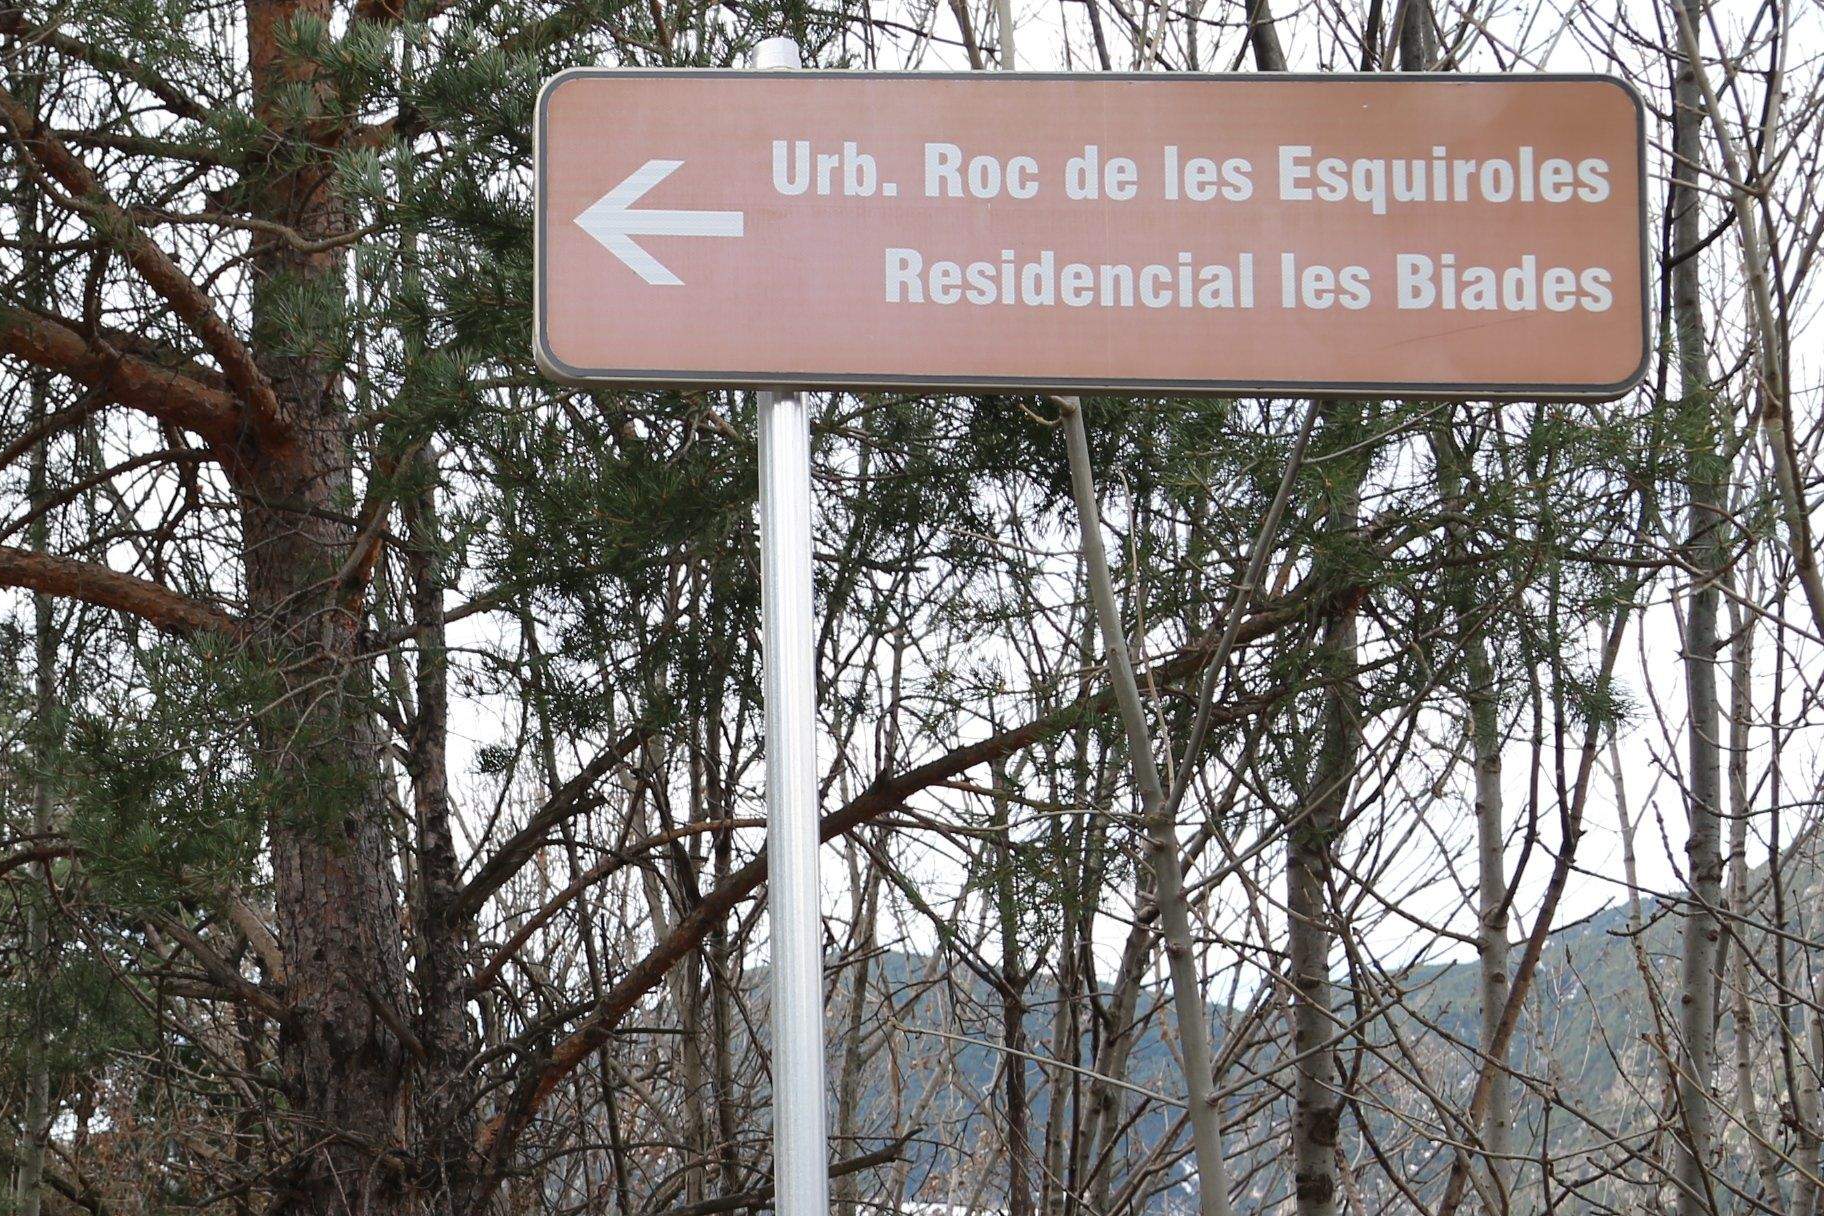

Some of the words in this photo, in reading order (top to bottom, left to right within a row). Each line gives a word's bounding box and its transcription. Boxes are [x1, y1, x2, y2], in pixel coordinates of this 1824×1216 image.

[771, 139, 898, 198] Urb.
[924, 142, 1039, 199] Roc
[1064, 144, 1138, 201] de
[1164, 145, 1254, 202] les
[1278, 145, 1610, 215] Esquiroles
[884, 247, 1254, 309] Residencial
[1281, 252, 1371, 310] les
[1396, 253, 1614, 312] Biades
